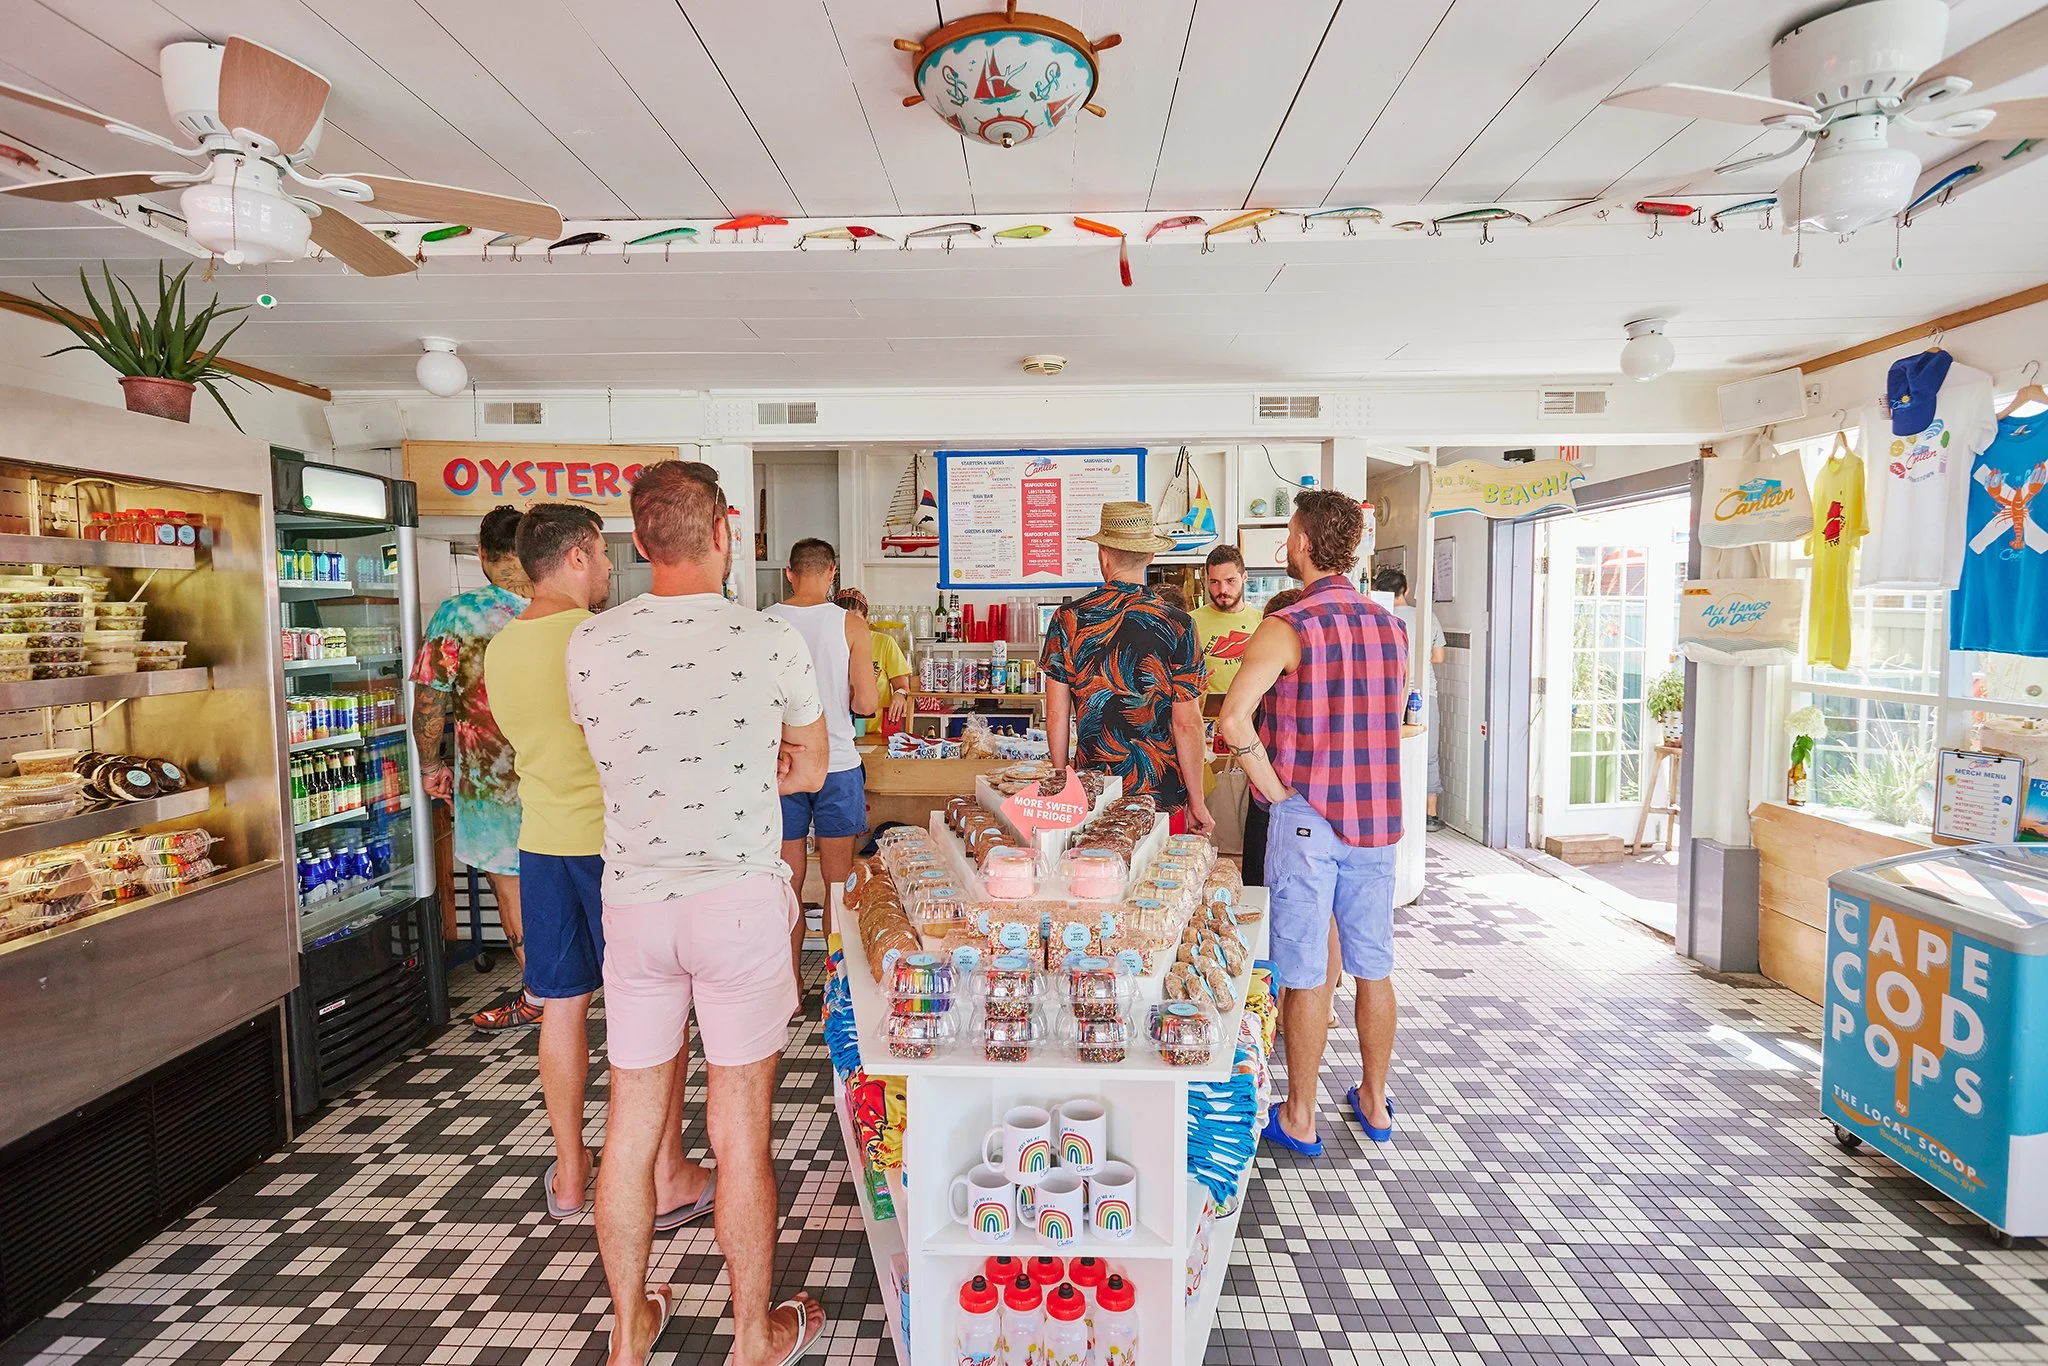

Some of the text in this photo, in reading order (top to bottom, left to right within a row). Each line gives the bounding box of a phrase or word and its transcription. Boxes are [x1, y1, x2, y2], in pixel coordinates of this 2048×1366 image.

[1483, 470, 1568, 506] BEACH!
[1715, 486, 1795, 521] Canteen
[1702, 600, 1771, 616] ALL HANDS
[1708, 611, 1765, 628] ON DECK
[1955, 768, 2006, 780] MERCH MENU
[1014, 797, 1084, 815] MORE SWEETS
[1023, 808, 1072, 823] IN FRIDGE
[1834, 902, 1990, 999] CAPE
[1833, 951, 1985, 1056] COD
[1832, 1003, 1984, 1115] POPS
[1895, 1100, 1907, 1113] by
[1833, 1084, 1977, 1178] THE LOCAL SCOOP
[962, 1355, 997, 1366] Canteen
